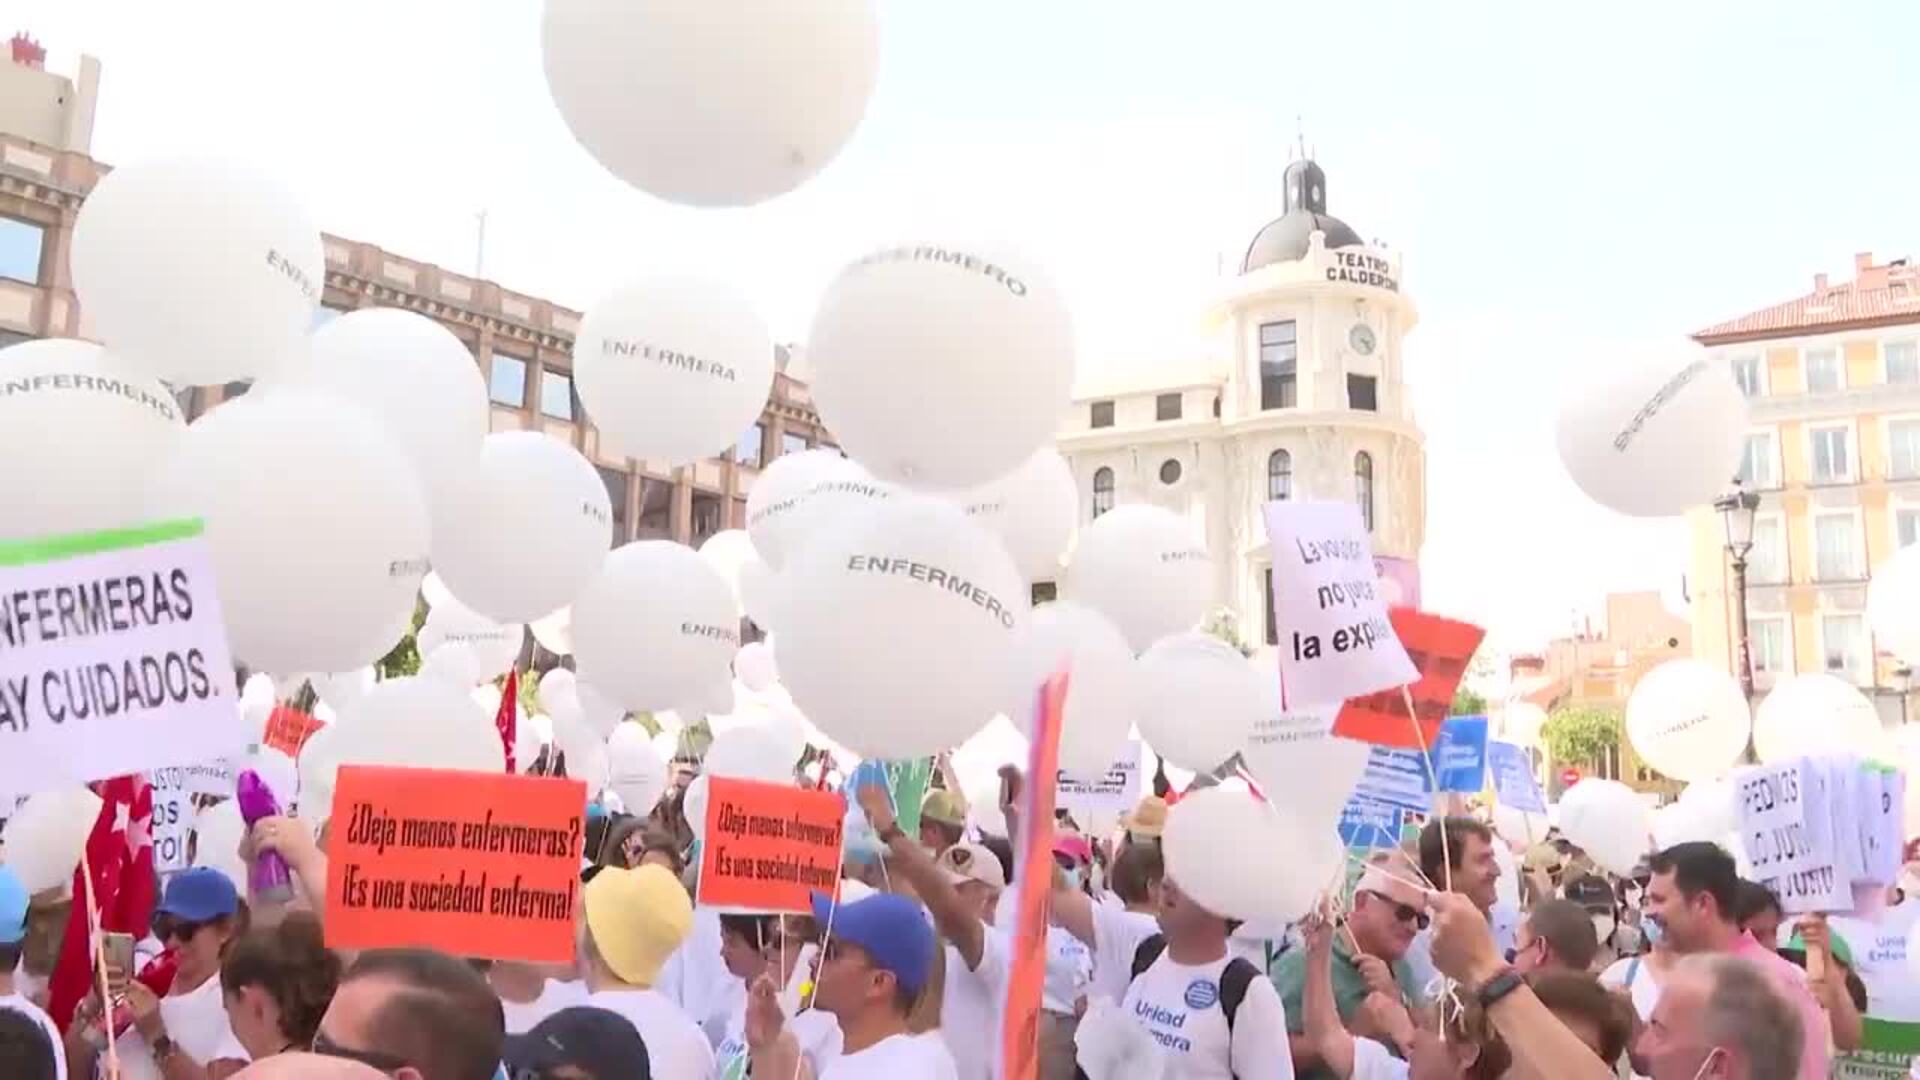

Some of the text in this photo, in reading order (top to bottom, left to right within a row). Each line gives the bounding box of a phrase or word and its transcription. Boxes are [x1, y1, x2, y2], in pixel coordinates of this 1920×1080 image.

[1336, 251, 1389, 274] TEATRO
[0, 374, 174, 420] NFERMERO
[847, 554, 1014, 630] ENFERMERO
[1317, 582, 1345, 610] no
[1293, 630, 1321, 661] la
[42, 648, 220, 724] CUIDADOS.
[347, 803, 580, 859] ¿Deja menos enfermeras?
[372, 877, 405, 911] una
[408, 869, 487, 914] sociedad
[489, 874, 574, 922] enferma!
[1135, 999, 1186, 1029] Unidad
